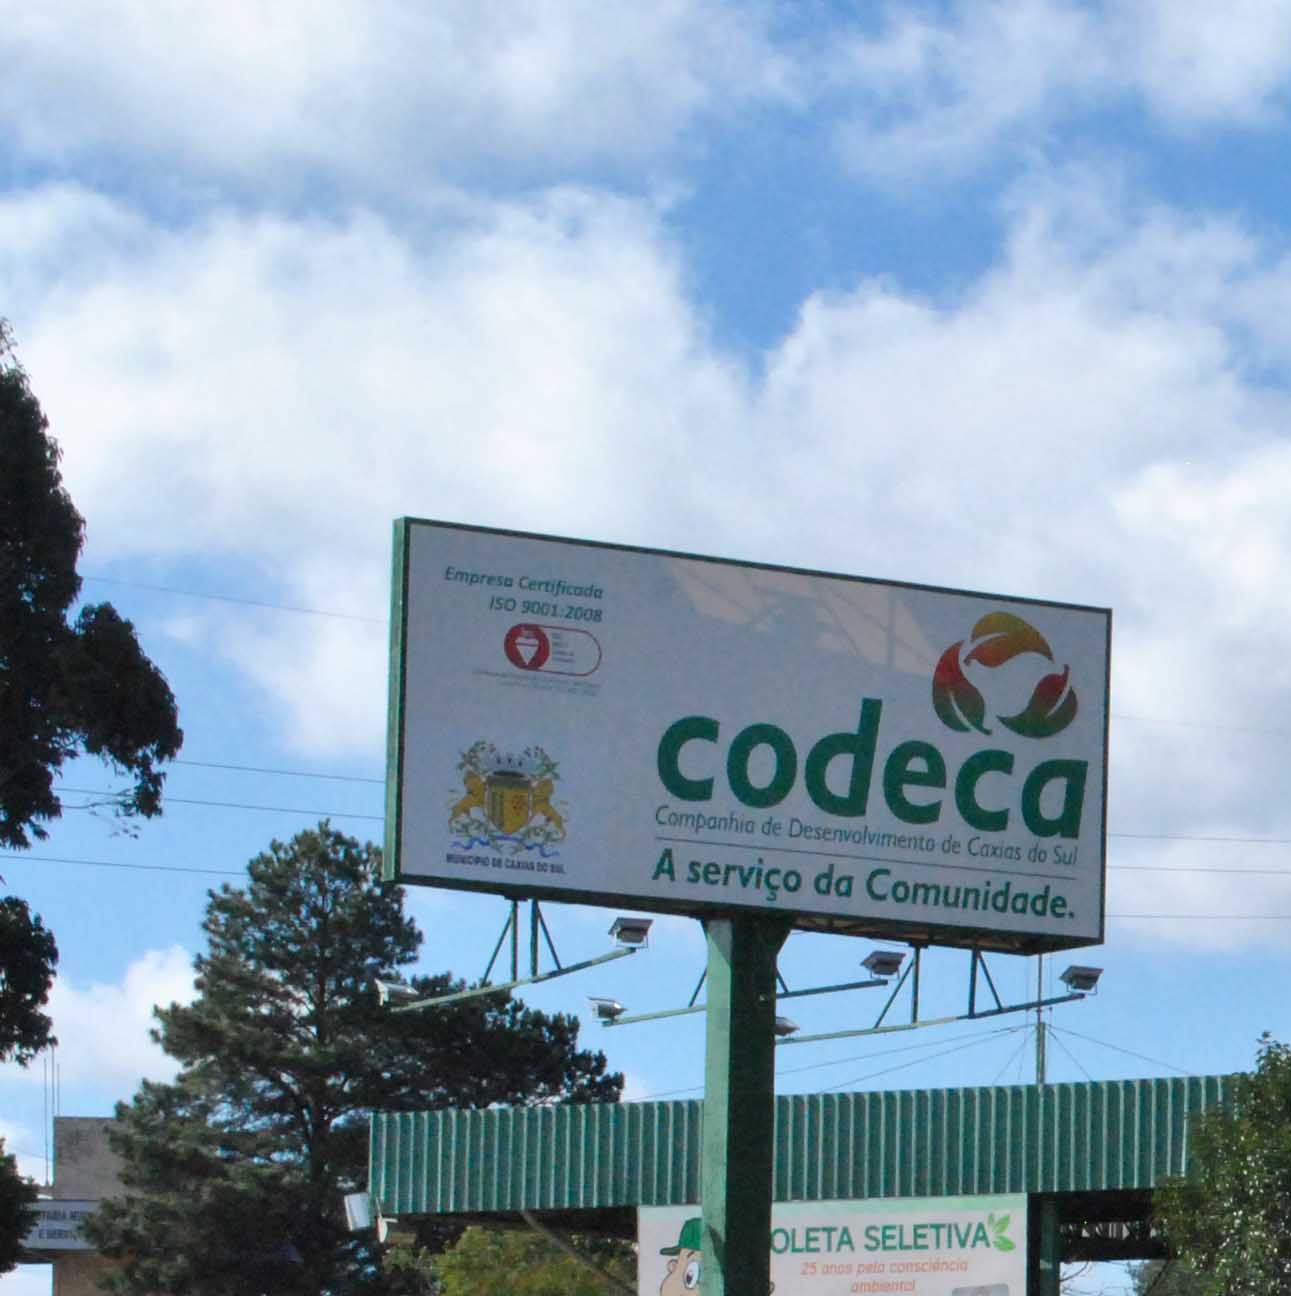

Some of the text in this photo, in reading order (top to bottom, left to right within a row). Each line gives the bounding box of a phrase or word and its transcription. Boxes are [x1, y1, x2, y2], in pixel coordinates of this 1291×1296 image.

[445, 566, 604, 600] Empresa Certificada
[490, 595, 603, 623] ISO 9001:2008
[657, 697, 1089, 840] codeca
[655, 805, 1079, 866] Companhia de Desenvolvimento de Caxias do Sul
[652, 848, 1076, 919] A serviço da Comunidade.
[771, 1221, 991, 1254] OLETA SELETIVA
[800, 1262, 817, 1276] 25
[821, 1263, 853, 1276] anos
[855, 1261, 885, 1277] pela
[849, 1280, 915, 1294] ambiental
